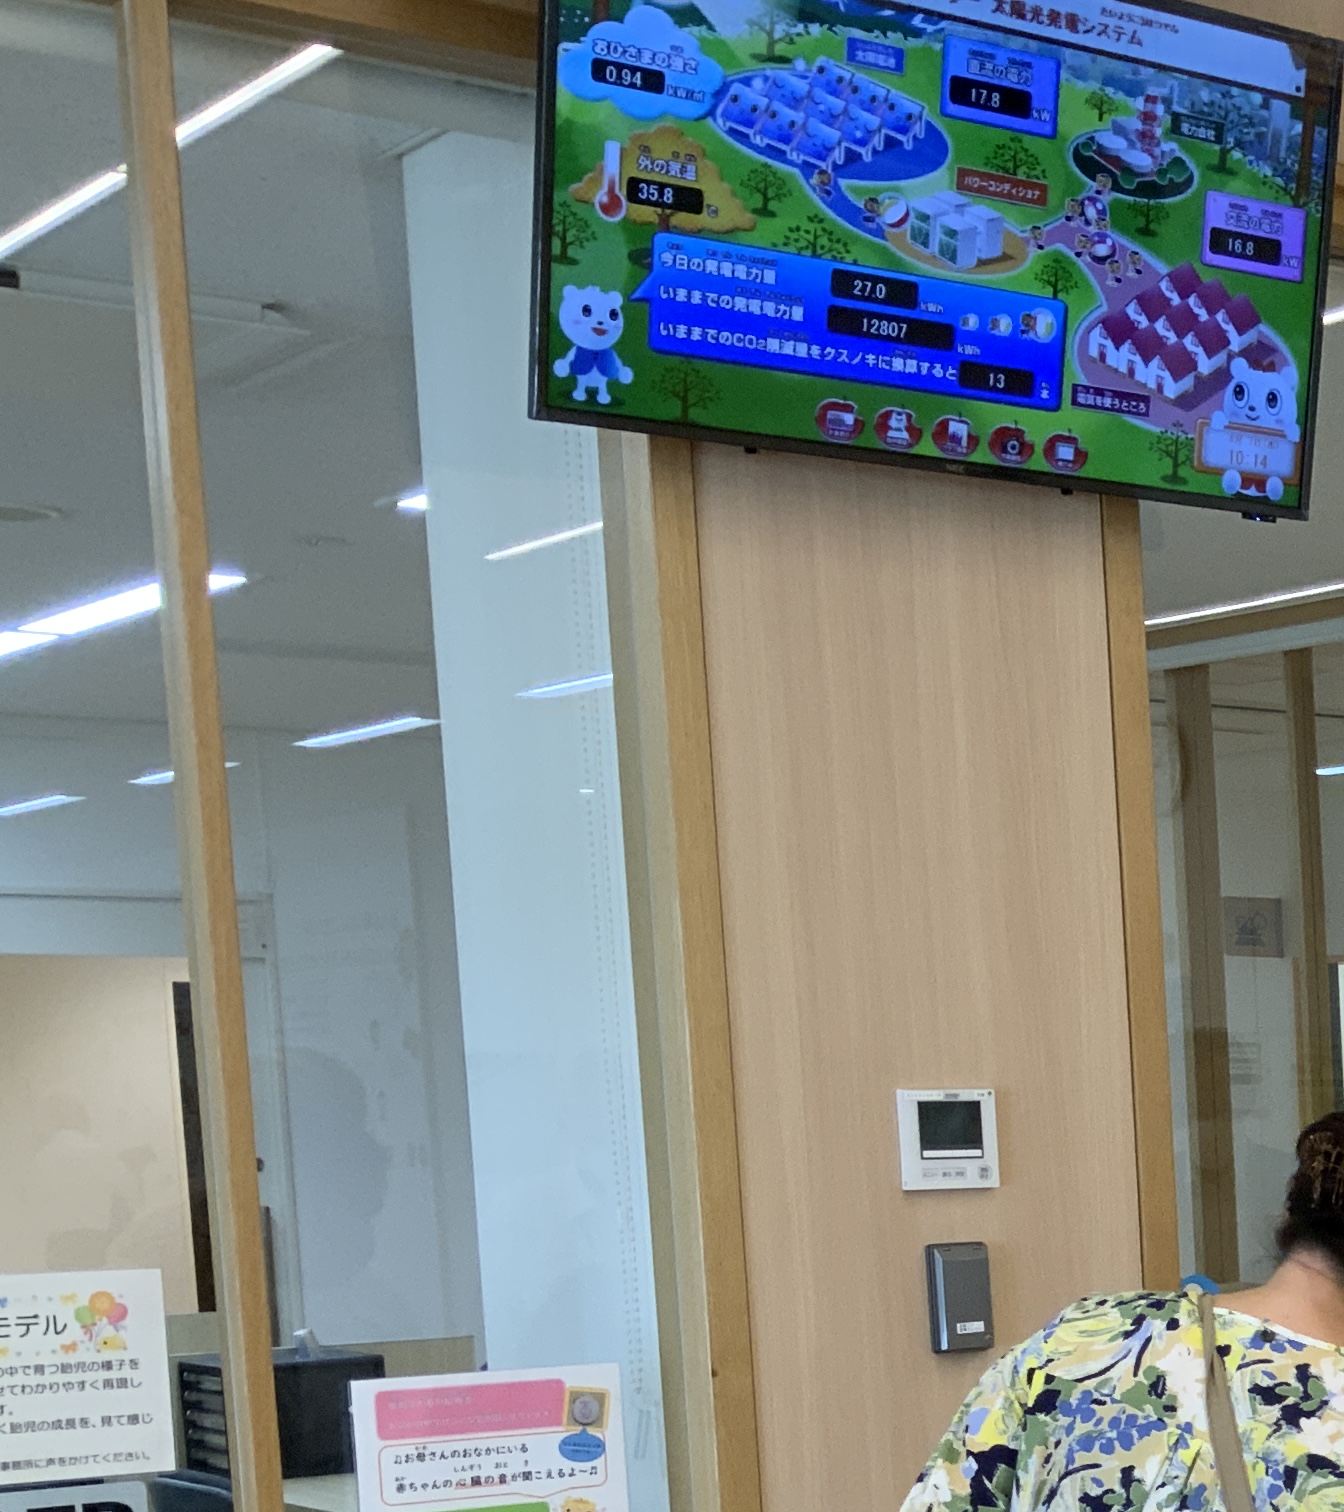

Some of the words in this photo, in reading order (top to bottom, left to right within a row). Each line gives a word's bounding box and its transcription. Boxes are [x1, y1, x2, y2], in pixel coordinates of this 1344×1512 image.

[592, 38, 699, 76] おひさまの強さ
[605, 65, 643, 88] 0.94
[970, 86, 1001, 109] 17.8
[636, 153, 698, 182] 外の気温
[638, 182, 674, 204] 35.8
[963, 174, 1042, 200] パワーコンディショナ
[1226, 237, 1255, 257] 16.8
[852, 278, 887, 300] 27.0
[861, 316, 909, 340] 12807
[988, 372, 1007, 390] 13
[1228, 450, 1268, 470] 10:14
